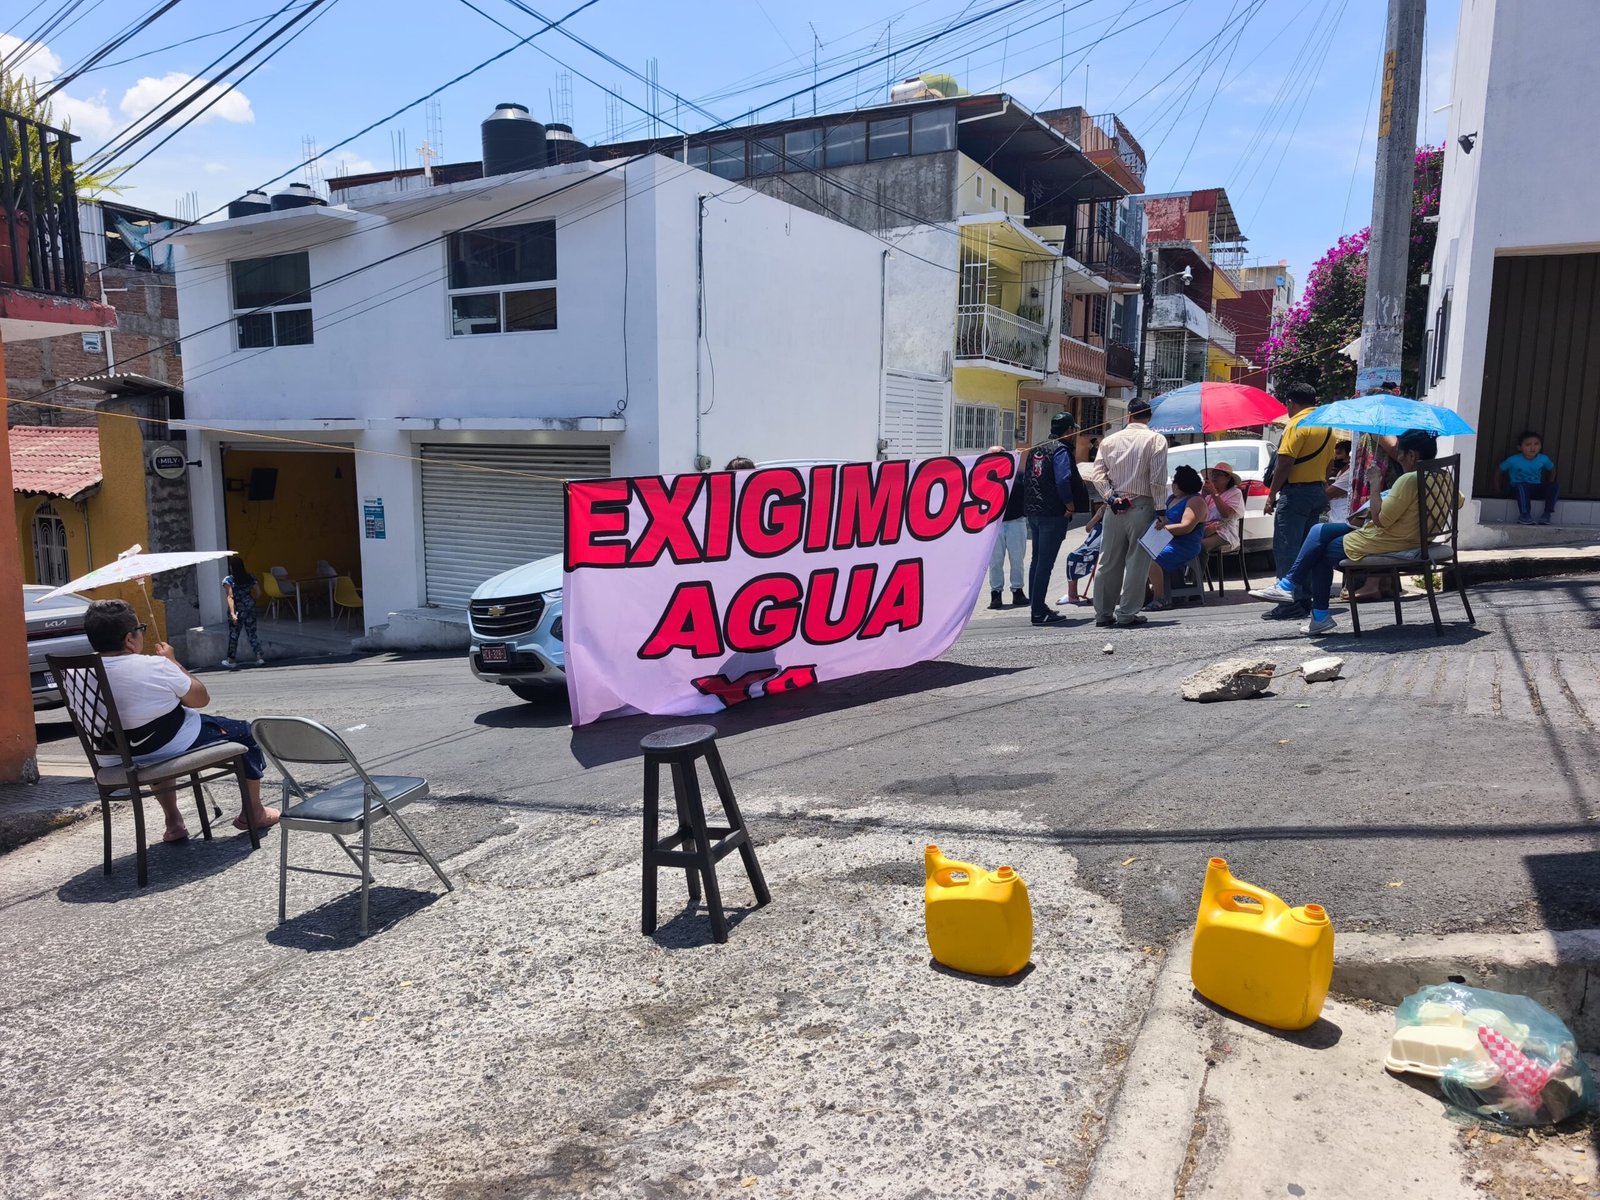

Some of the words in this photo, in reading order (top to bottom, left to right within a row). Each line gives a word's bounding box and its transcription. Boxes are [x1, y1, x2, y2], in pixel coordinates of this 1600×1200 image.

[564, 451, 1015, 572] EXIGIMOS
[45, 619, 67, 628] KIA
[637, 558, 924, 660] AGUA
